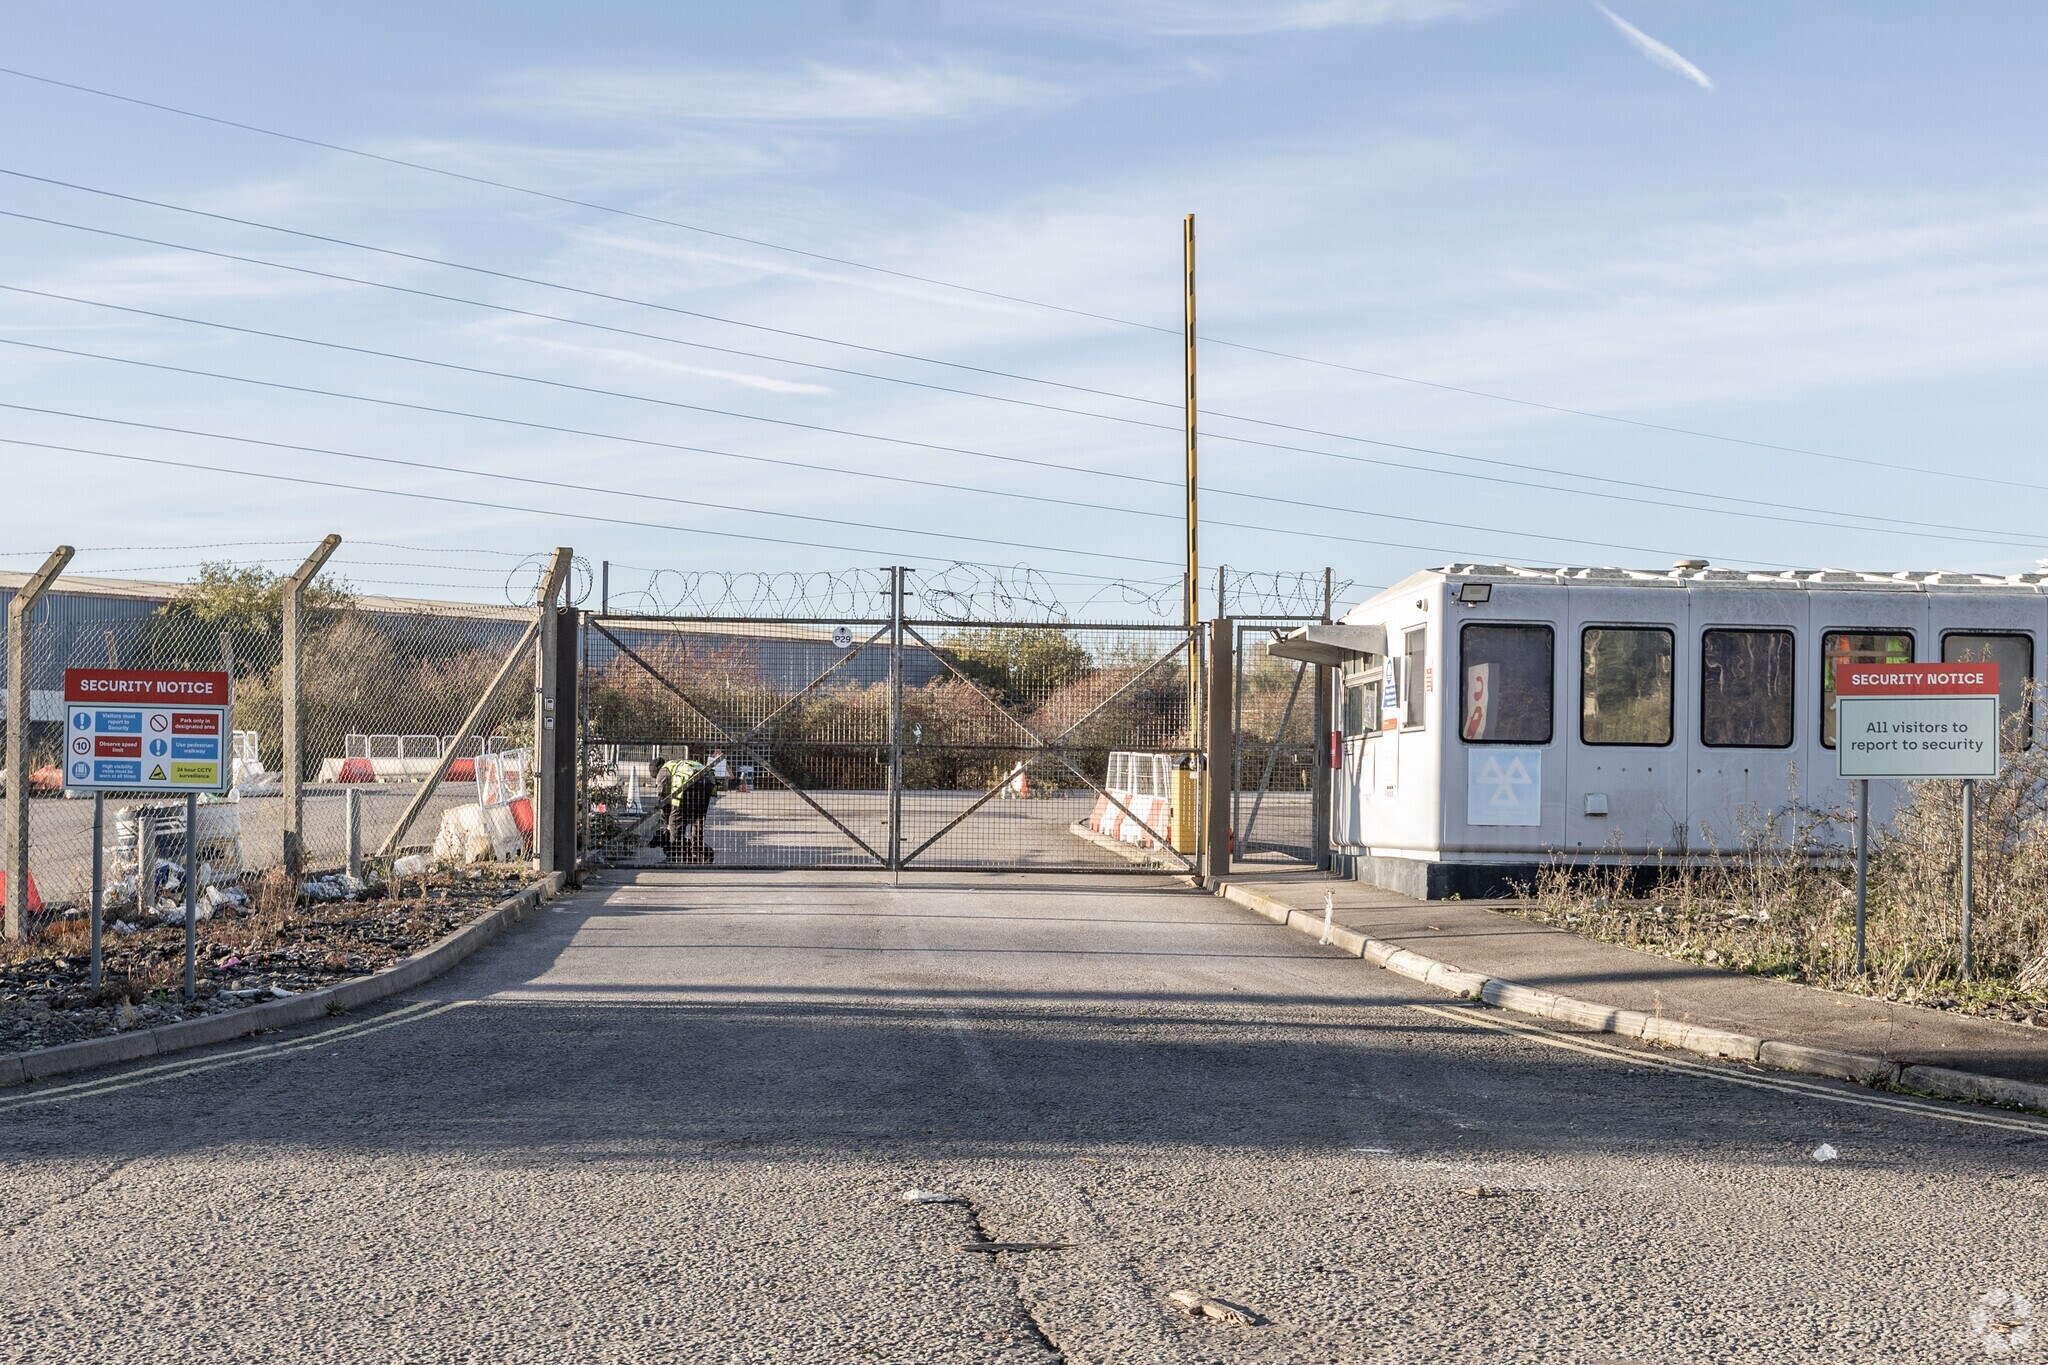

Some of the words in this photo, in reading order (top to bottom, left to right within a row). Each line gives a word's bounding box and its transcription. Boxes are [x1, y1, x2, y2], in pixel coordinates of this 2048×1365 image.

[834, 635, 851, 643] P29
[1851, 673, 1924, 686] SECURITY
[1927, 672, 1984, 685] NOTICE
[80, 679, 153, 692] SECURITY
[156, 681, 213, 694] NOTICE
[1866, 721, 1888, 733] All
[1892, 721, 1948, 733] visitors
[1952, 722, 1968, 733] to
[76, 741, 88, 751] 10
[1851, 739, 1898, 753] report
[1902, 740, 1918, 750] to
[1922, 738, 1983, 753] security
